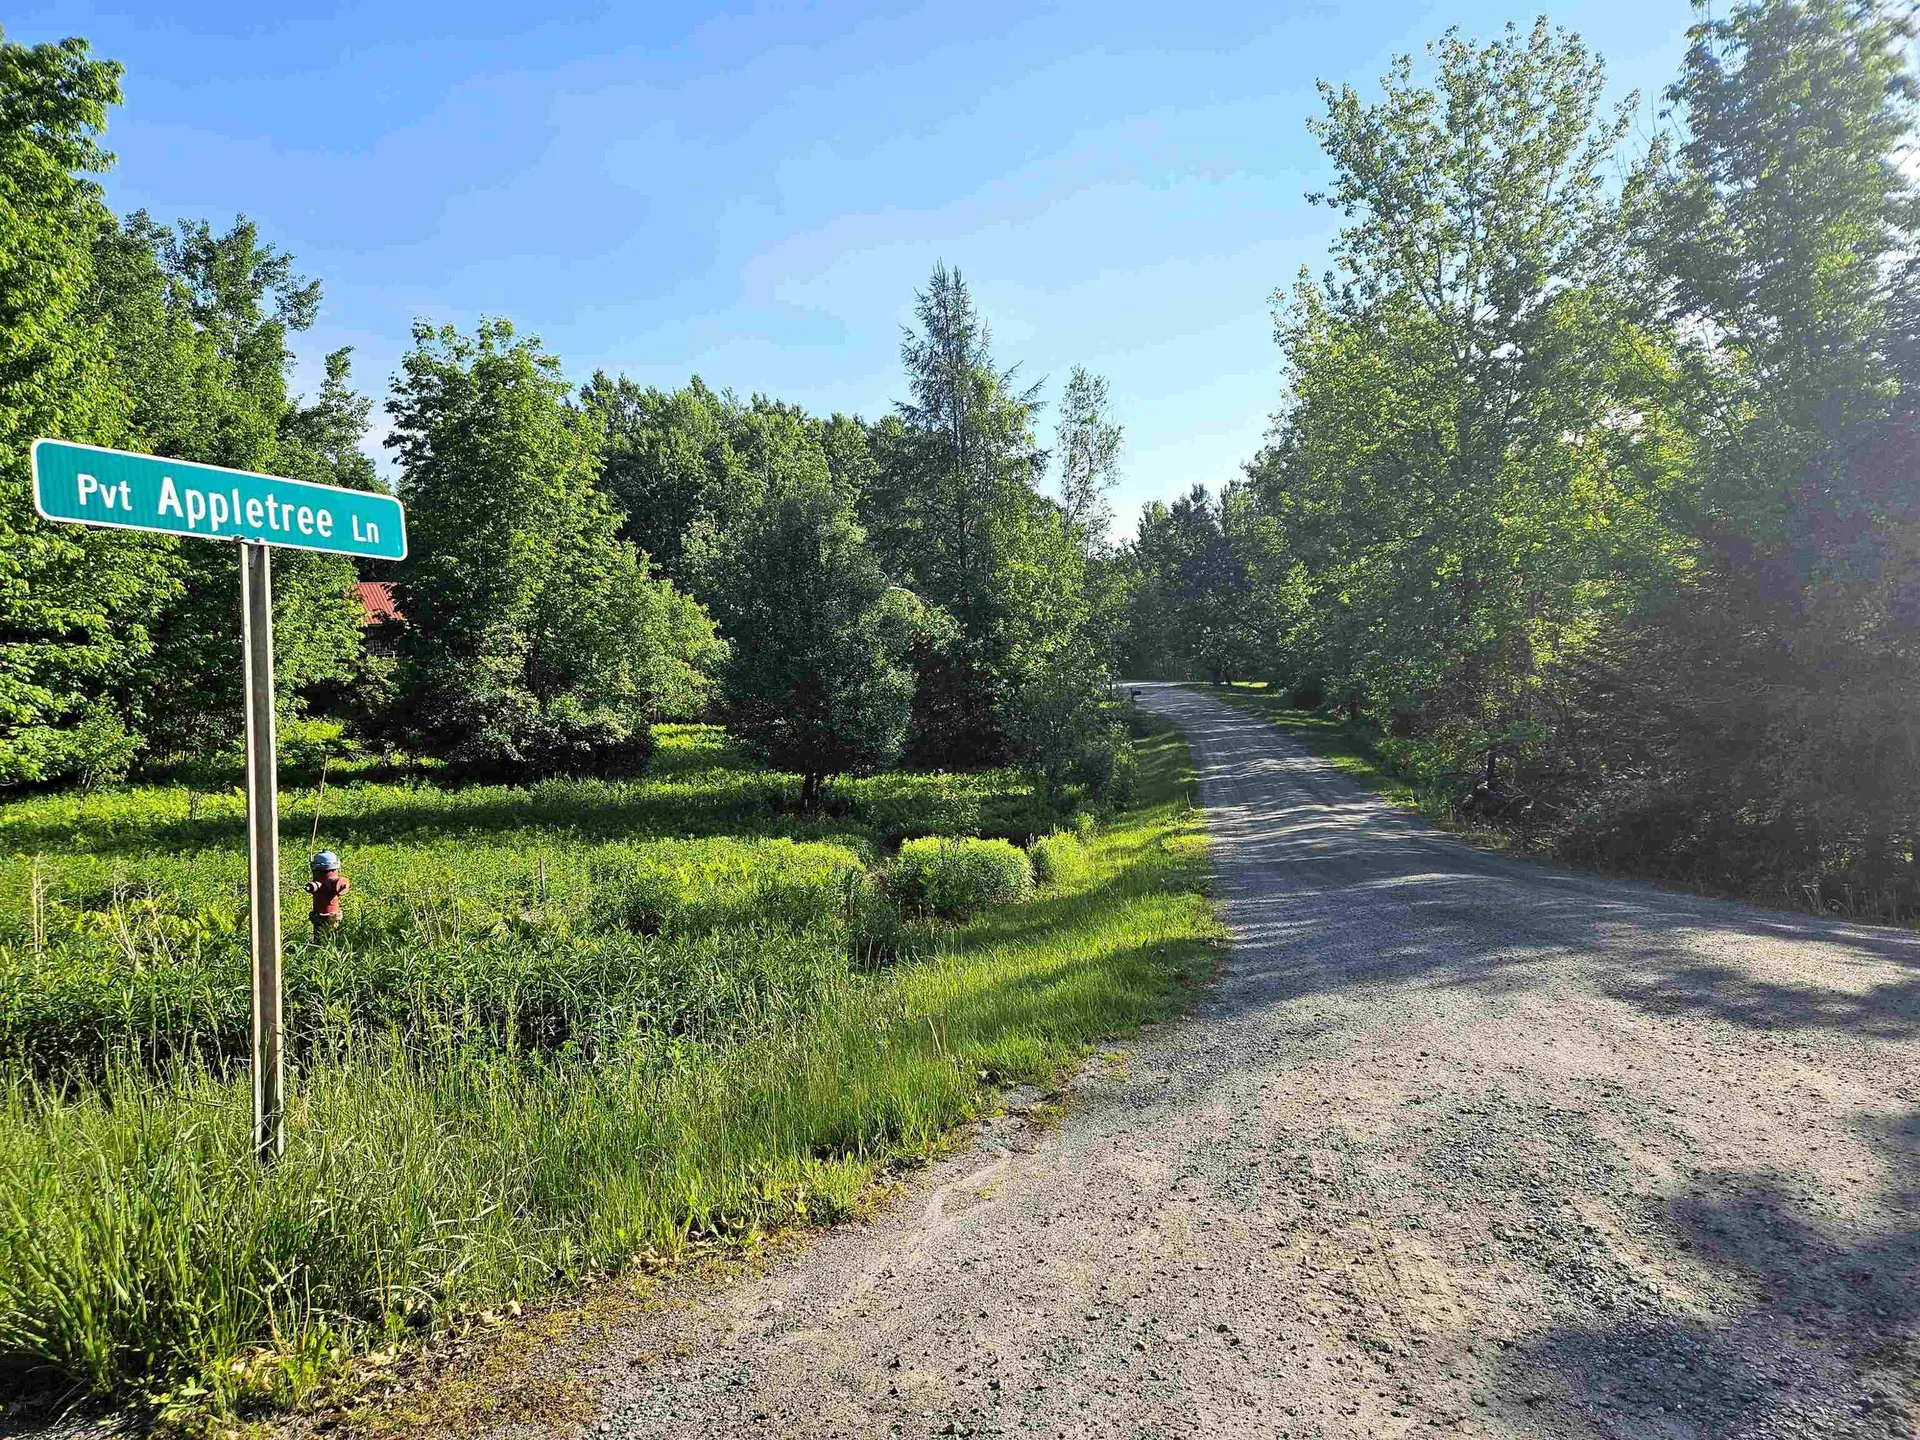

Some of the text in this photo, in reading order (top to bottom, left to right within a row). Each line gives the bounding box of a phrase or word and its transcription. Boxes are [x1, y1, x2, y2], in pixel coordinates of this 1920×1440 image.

[76, 473, 380, 544] Pvt Appletree Ln
